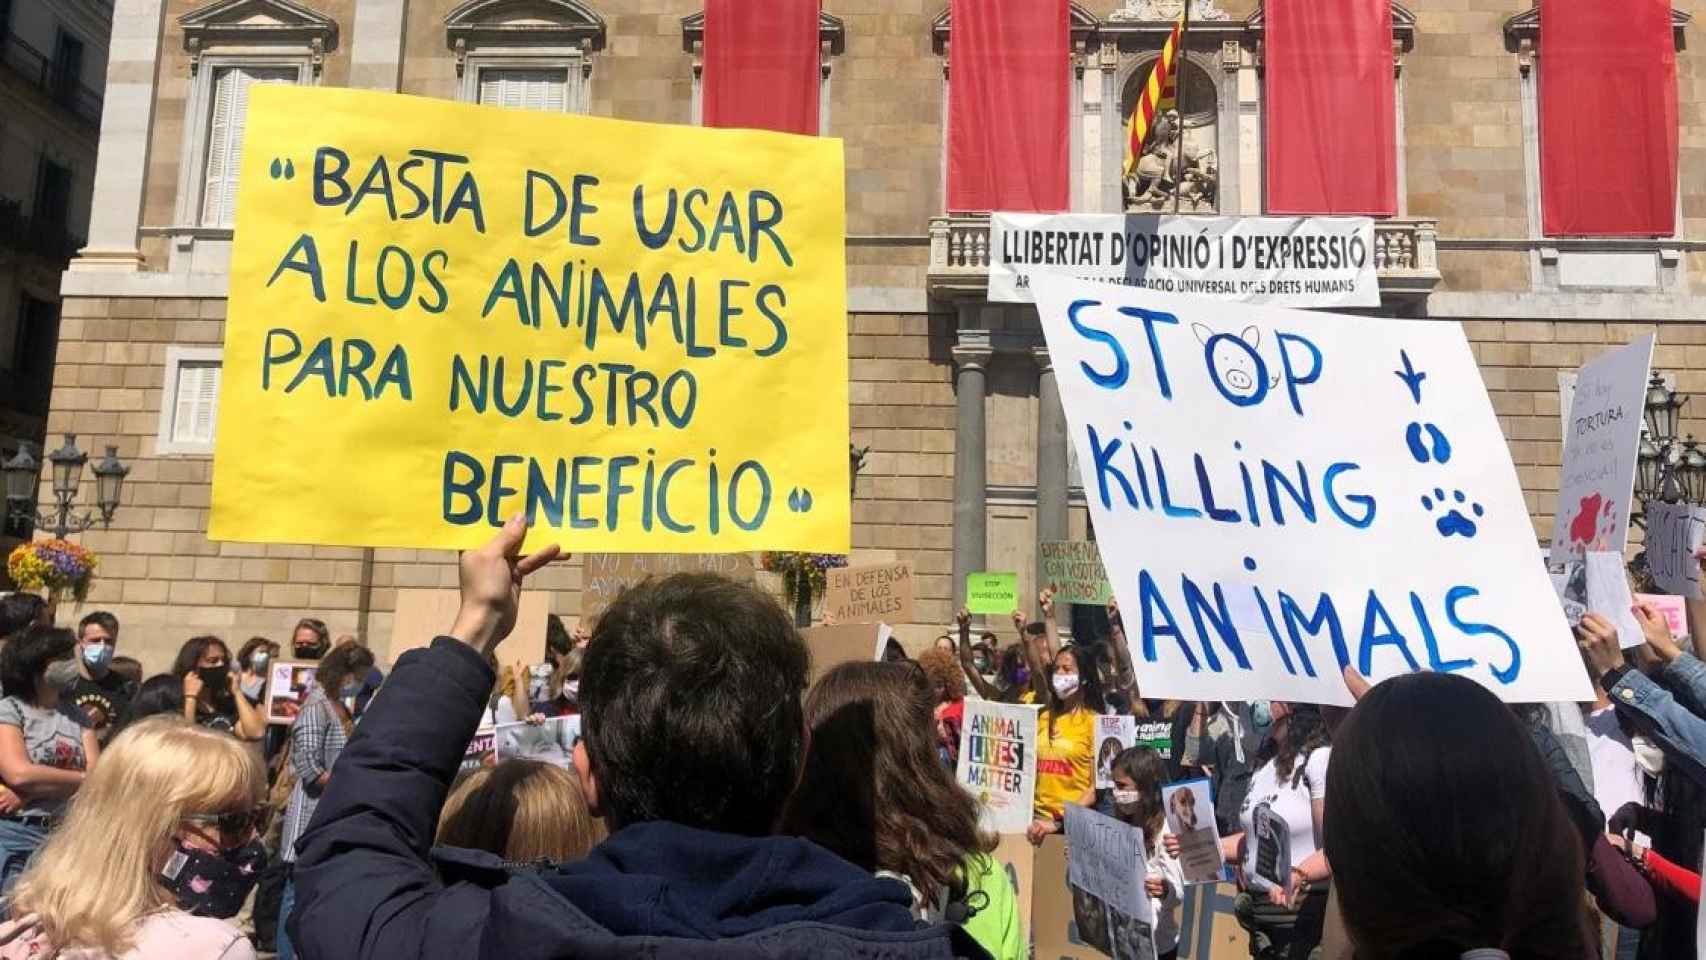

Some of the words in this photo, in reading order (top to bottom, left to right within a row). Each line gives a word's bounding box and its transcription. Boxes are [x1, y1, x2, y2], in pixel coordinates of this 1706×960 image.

[524, 170, 600, 246] DE
[633, 187, 793, 267] USAR
[1003, 230, 1104, 266] LLIBERTAT
[1111, 227, 1211, 269] D'OPINIÓ
[1218, 236, 1225, 269] I
[1232, 228, 1367, 269] D'EXPRESSIÓ
[267, 233, 326, 302] A
[347, 240, 449, 314] LOS
[1177, 279, 1237, 294] UNIVERSAL
[1269, 280, 1301, 294] DRETS
[1304, 279, 1355, 294] HUMANS
[1067, 299, 1323, 414] STOP
[263, 328, 412, 401] PARA
[449, 353, 698, 429] NUESTRO
[1575, 405, 1624, 437] TORTURA
[833, 573, 850, 590] EN
[855, 565, 910, 587] DEFENSA
[850, 588, 866, 602] DE
[871, 583, 892, 599] LOS
[837, 596, 902, 620] ANIMALES
[971, 713, 1023, 740] ANIMAL
[970, 735, 1023, 771] LIVES
[969, 764, 1021, 793] MATTER
